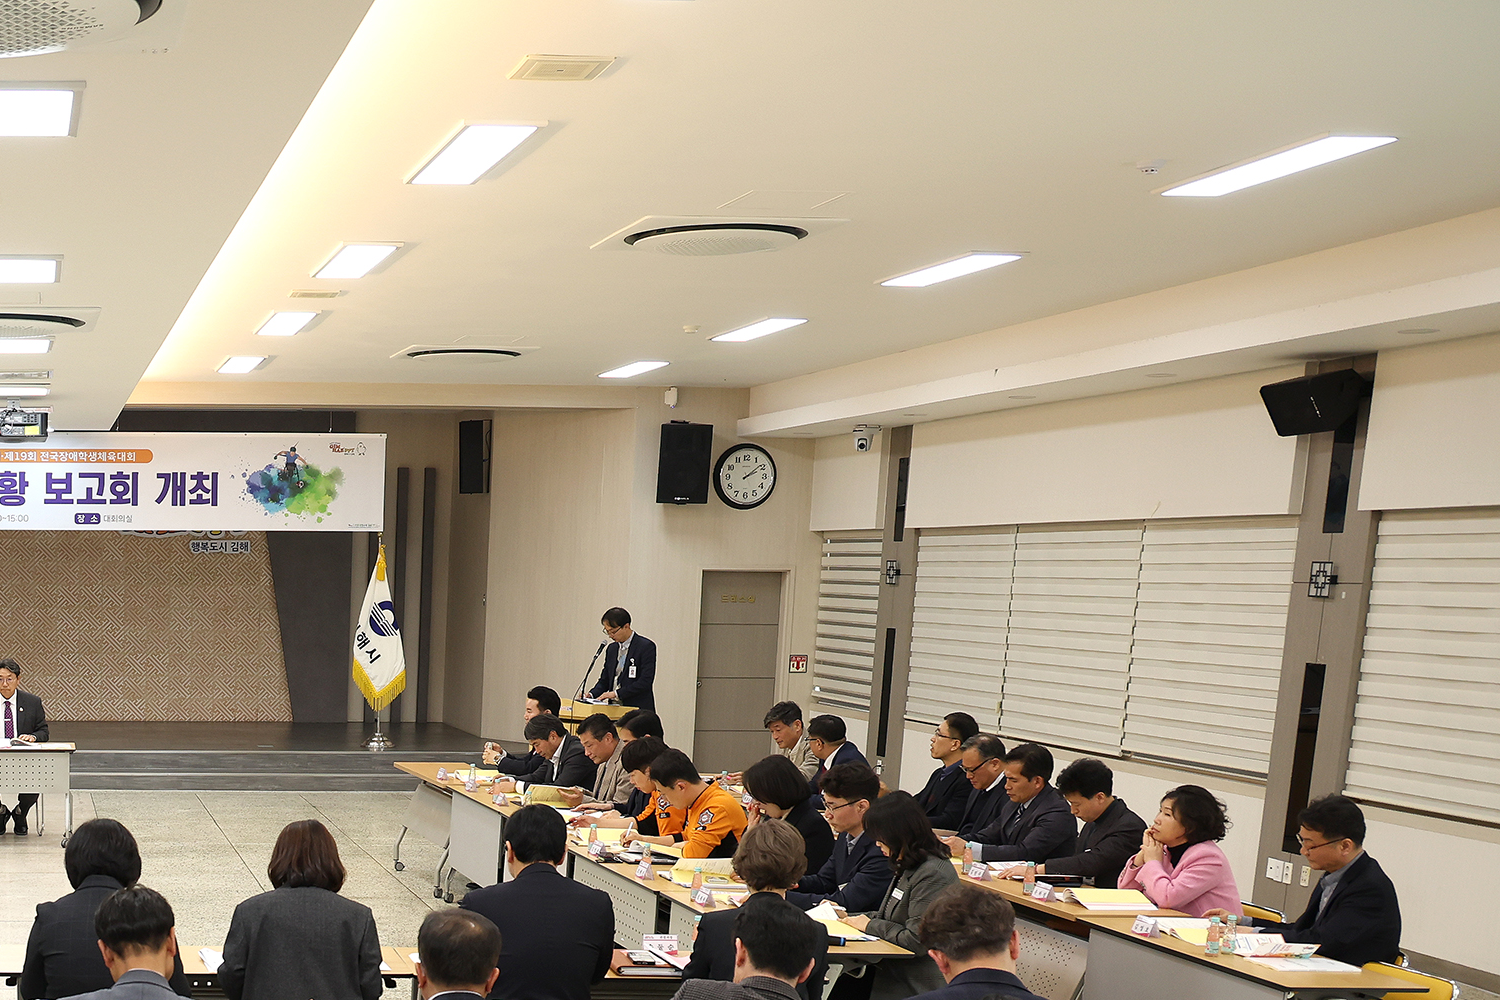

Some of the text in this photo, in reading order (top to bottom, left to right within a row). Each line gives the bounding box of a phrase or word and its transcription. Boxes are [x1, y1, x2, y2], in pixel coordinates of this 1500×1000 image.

[40, 451, 136, 462] 전국장애학생체육대회
[743, 454, 751, 462] 12
[760, 463, 766, 471] 2
[43, 471, 139, 507] 보고회
[155, 471, 219, 507] 개최
[727, 482, 733, 490] 8
[103, 514, 134, 524] 대회의실
[191, 541, 249, 553] 행복도시 김해
[356, 624, 382, 665] 해시
